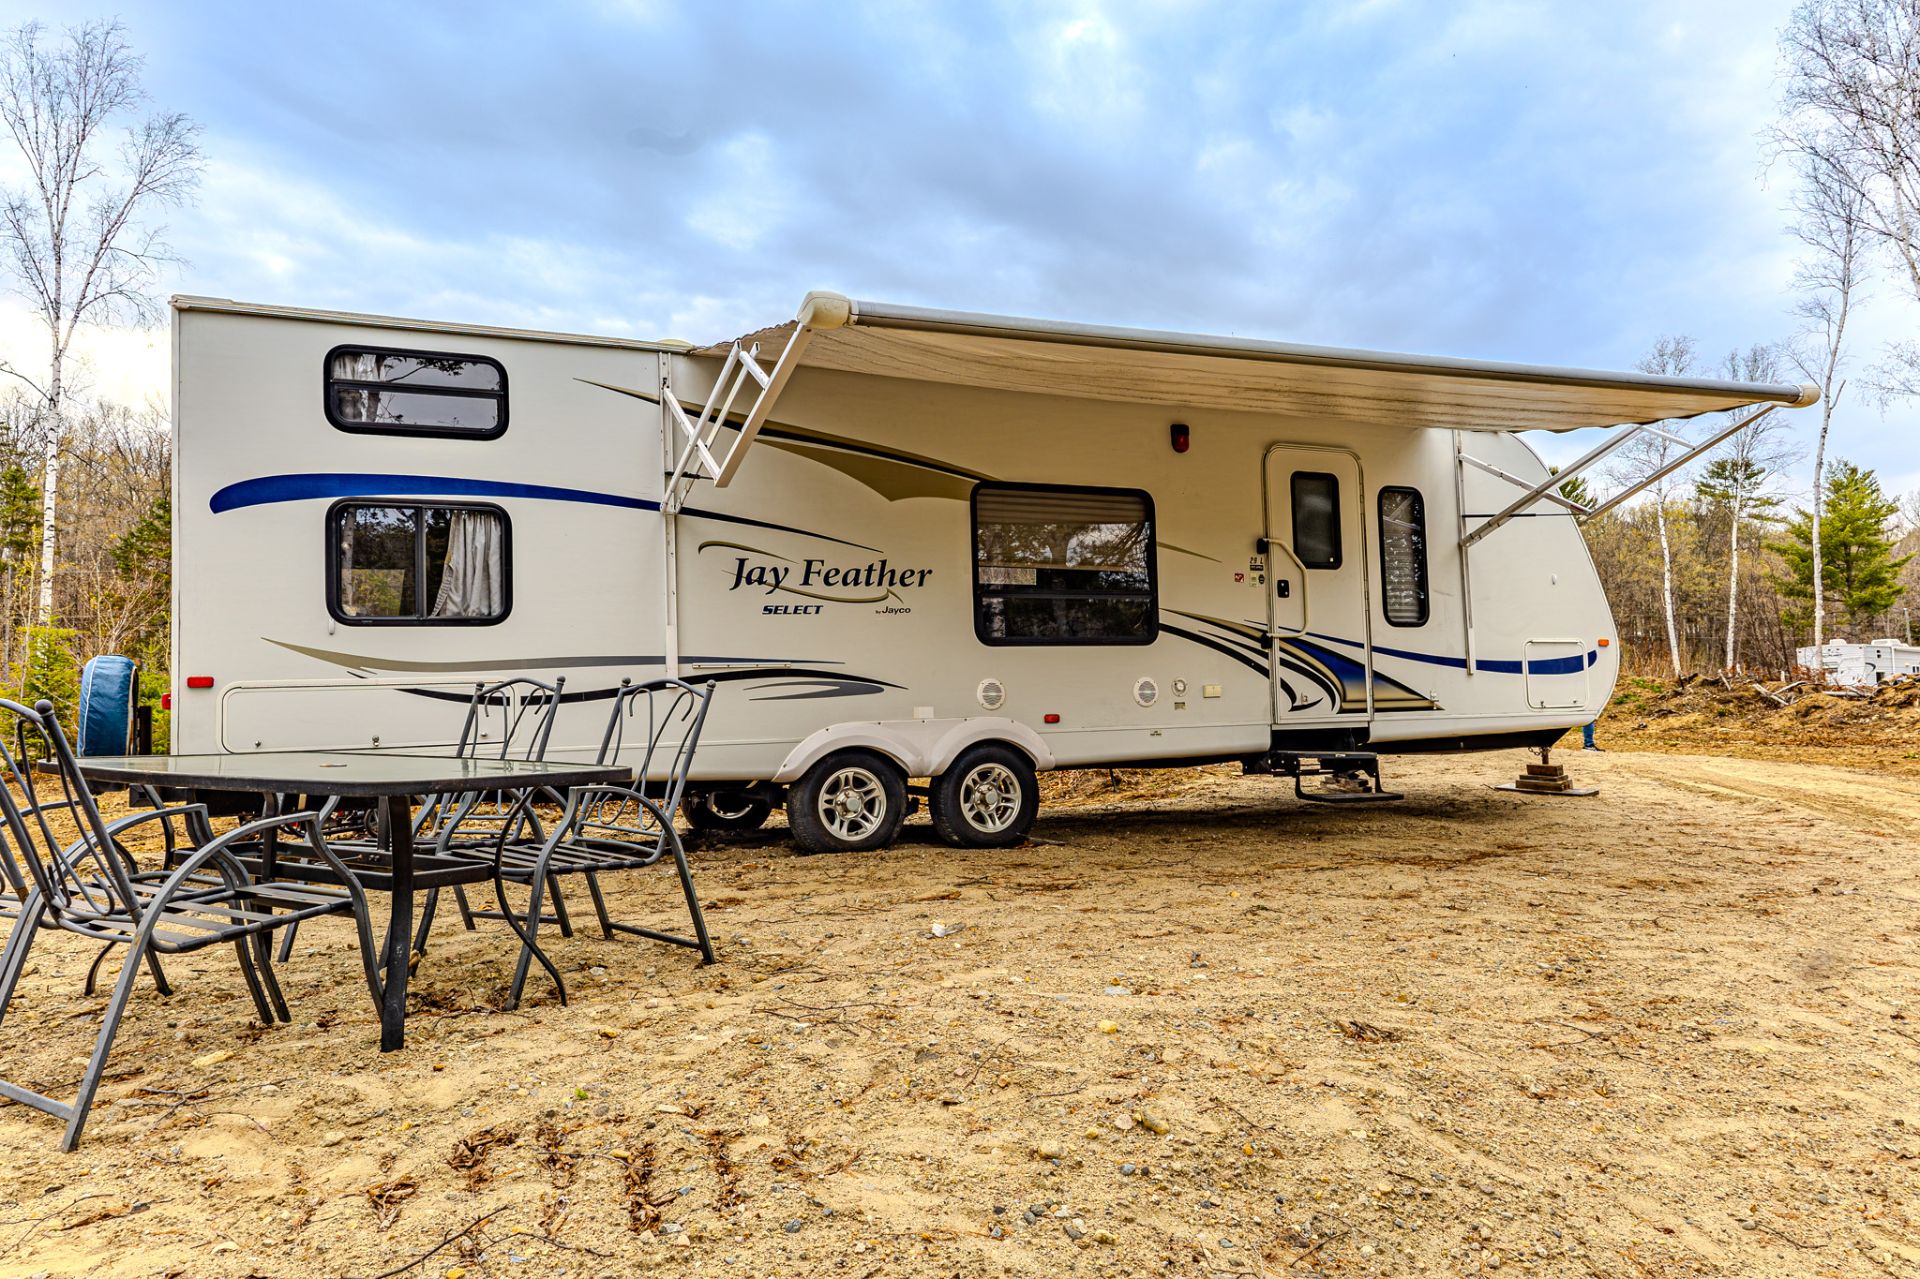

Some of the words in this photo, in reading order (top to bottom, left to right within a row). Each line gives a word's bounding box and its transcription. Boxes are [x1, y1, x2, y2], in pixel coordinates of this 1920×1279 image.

[729, 557, 790, 595] Jay
[799, 558, 932, 588] Feather
[762, 604, 824, 615] SELECT
[882, 605, 911, 615] Jayco
